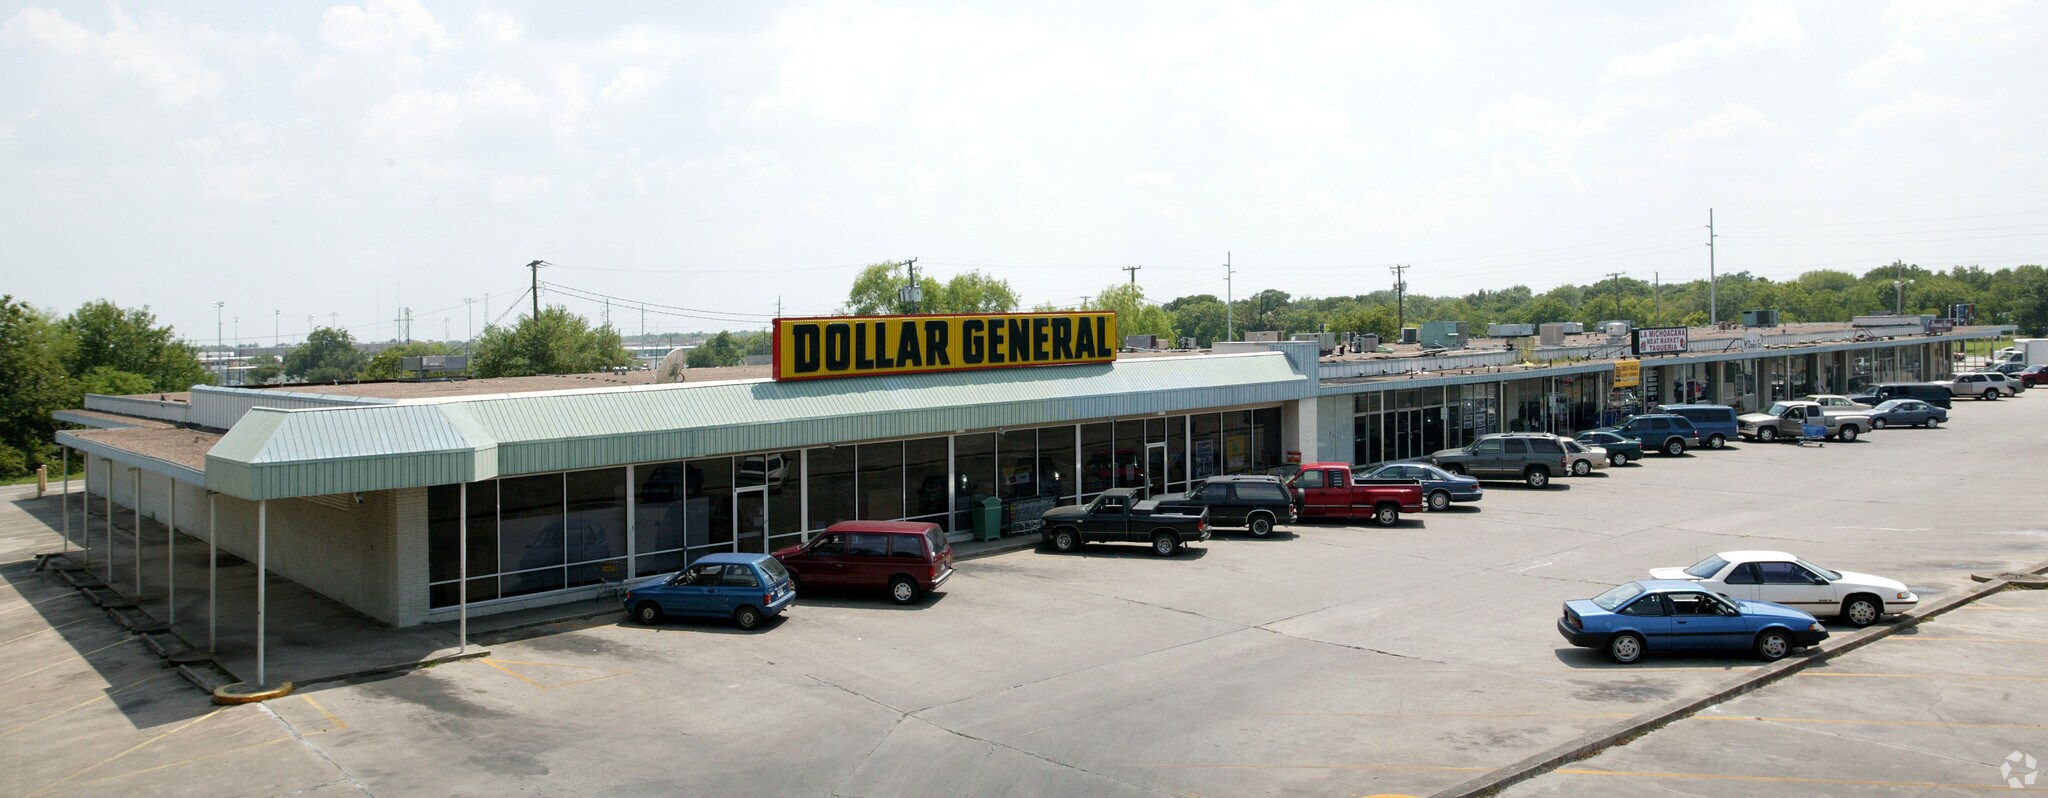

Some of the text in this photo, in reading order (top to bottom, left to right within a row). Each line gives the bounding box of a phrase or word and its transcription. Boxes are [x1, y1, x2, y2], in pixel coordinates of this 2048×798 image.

[793, 317, 1112, 373] DOLLAR GENERAL
[1649, 329, 1685, 337] MICHOACANA
